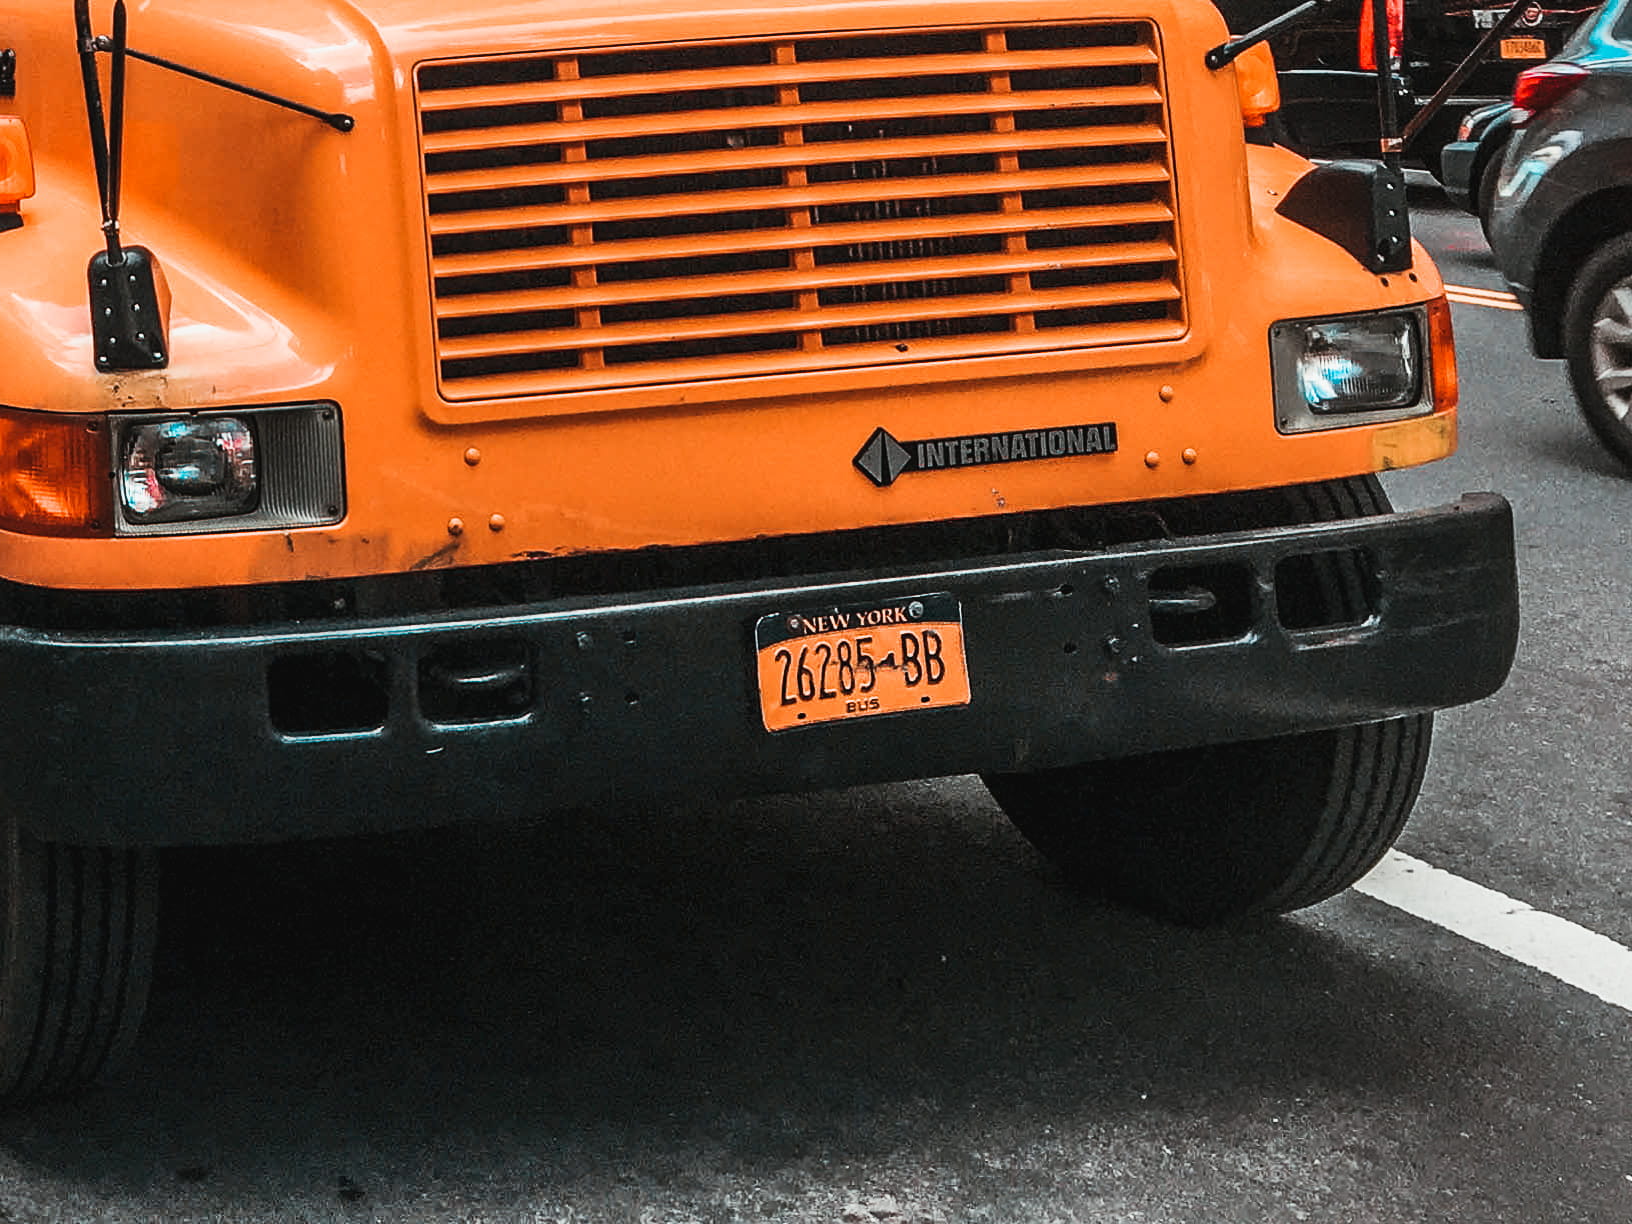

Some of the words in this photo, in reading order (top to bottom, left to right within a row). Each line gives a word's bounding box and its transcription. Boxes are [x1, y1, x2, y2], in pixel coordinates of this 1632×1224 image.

[917, 424, 1117, 469] INTERNATIONAL
[802, 612, 851, 635] NEW
[855, 606, 909, 626] YORK
[846, 697, 881, 714] BUS
